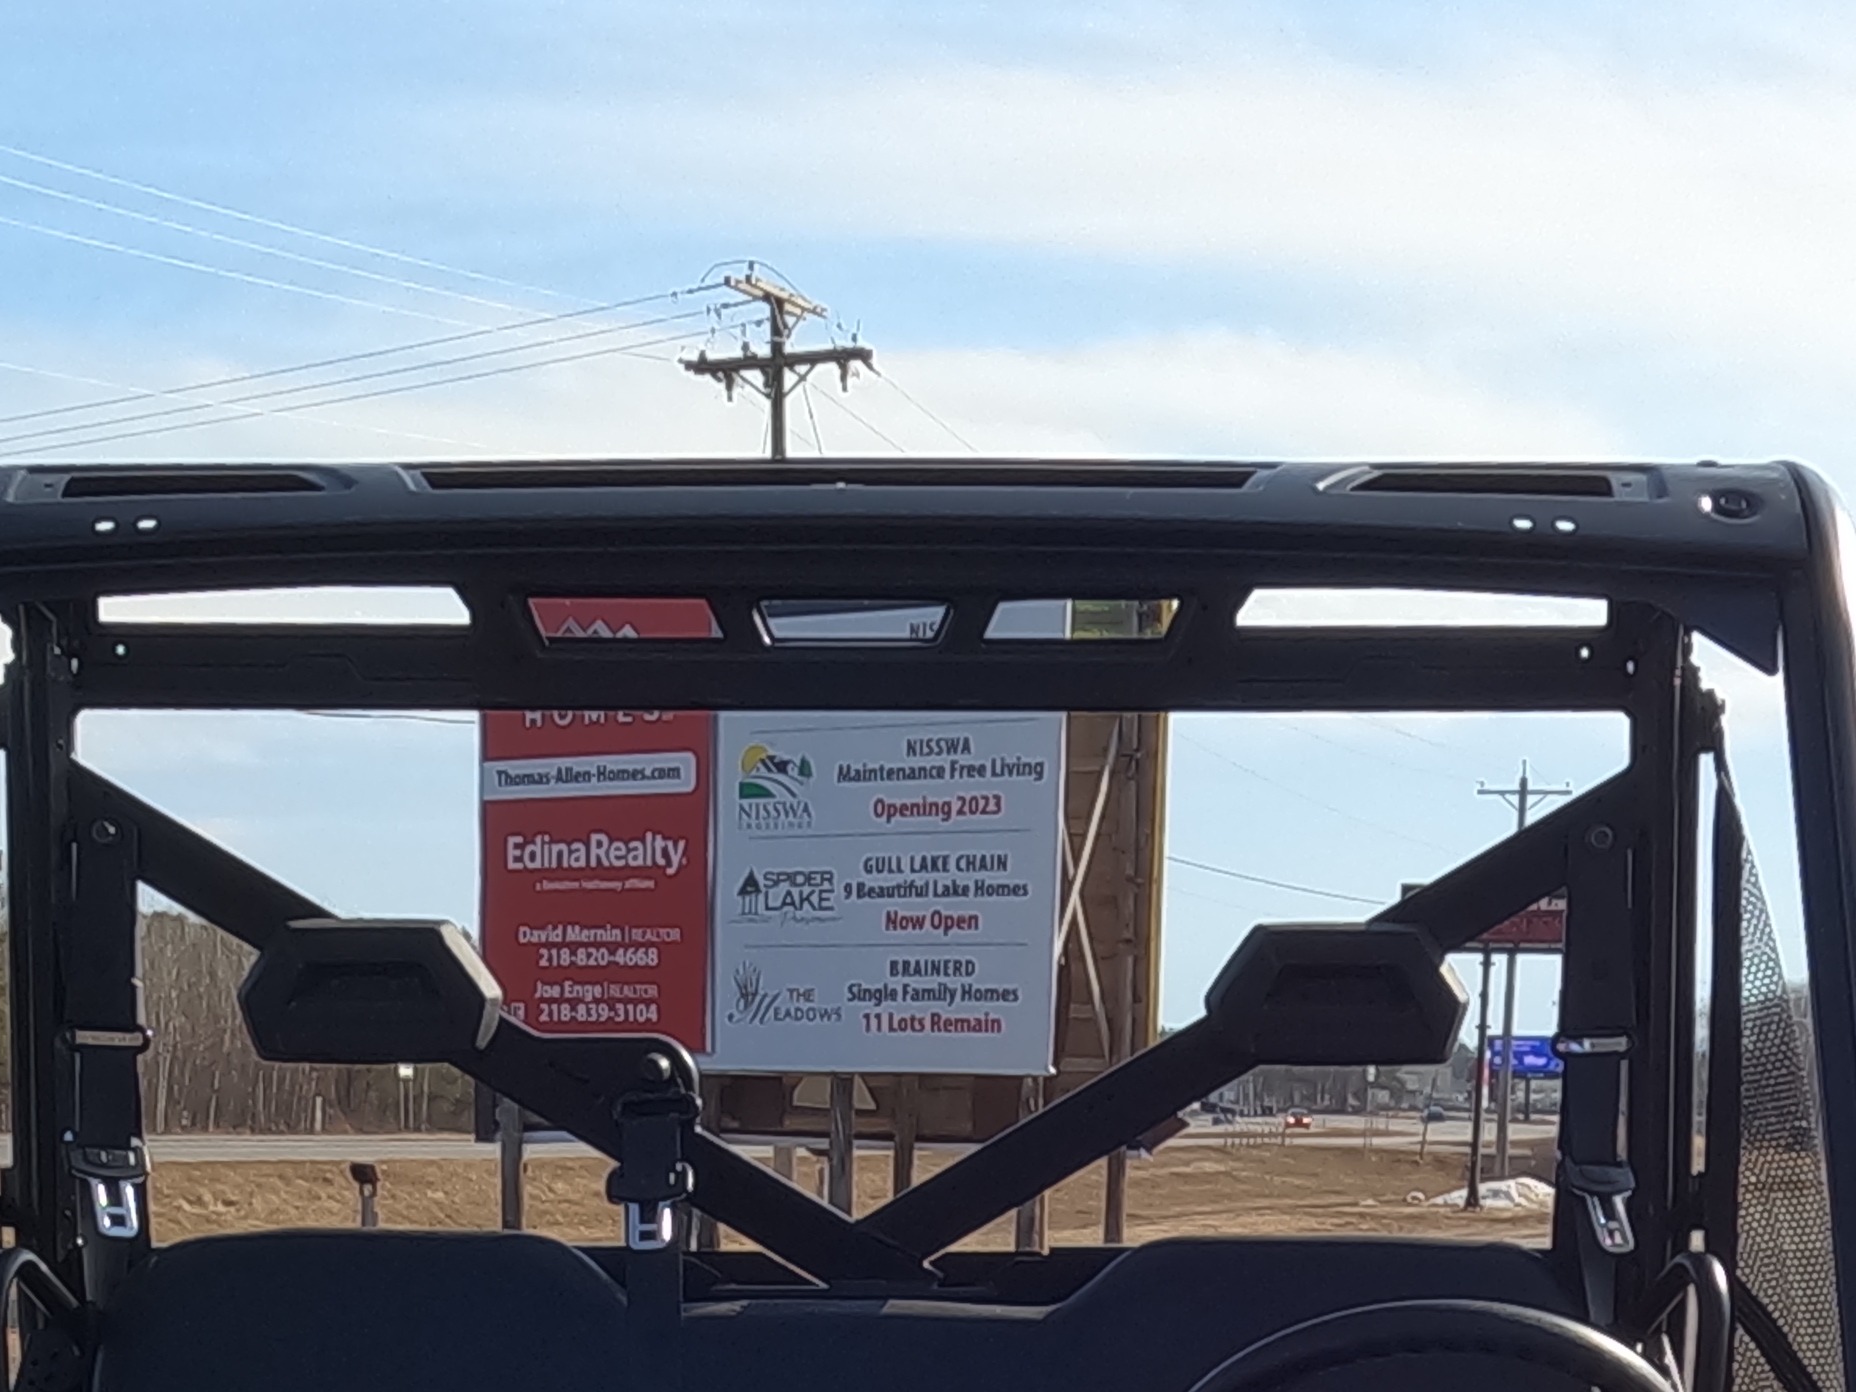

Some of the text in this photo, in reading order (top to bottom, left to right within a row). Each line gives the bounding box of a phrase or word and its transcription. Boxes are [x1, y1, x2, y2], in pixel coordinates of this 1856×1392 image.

[907, 737, 972, 757] NISSWA
[496, 765, 682, 787] Thomas-Allen-Homes.com
[837, 757, 1045, 783] Maintenance Free Living
[739, 801, 812, 820] NISSWA
[873, 794, 1003, 824] Opening 2023
[863, 854, 1008, 875] GULL LAKE CHAIN
[763, 871, 834, 888] SPIDER
[764, 889, 835, 911] LAKE
[844, 880, 1029, 900] 9 Beautiful Lake Homes
[885, 910, 980, 936] Now Open
[518, 924, 563, 943] David
[538, 948, 659, 967] 218-820-4668
[889, 960, 976, 978] BRAINERD
[535, 980, 561, 998] Joe
[786, 987, 816, 1003] THE
[847, 983, 1019, 1007] Single Family Homes
[538, 1003, 659, 1022] 218-839-3104
[862, 1012, 1002, 1033] 11 Lots Remain
